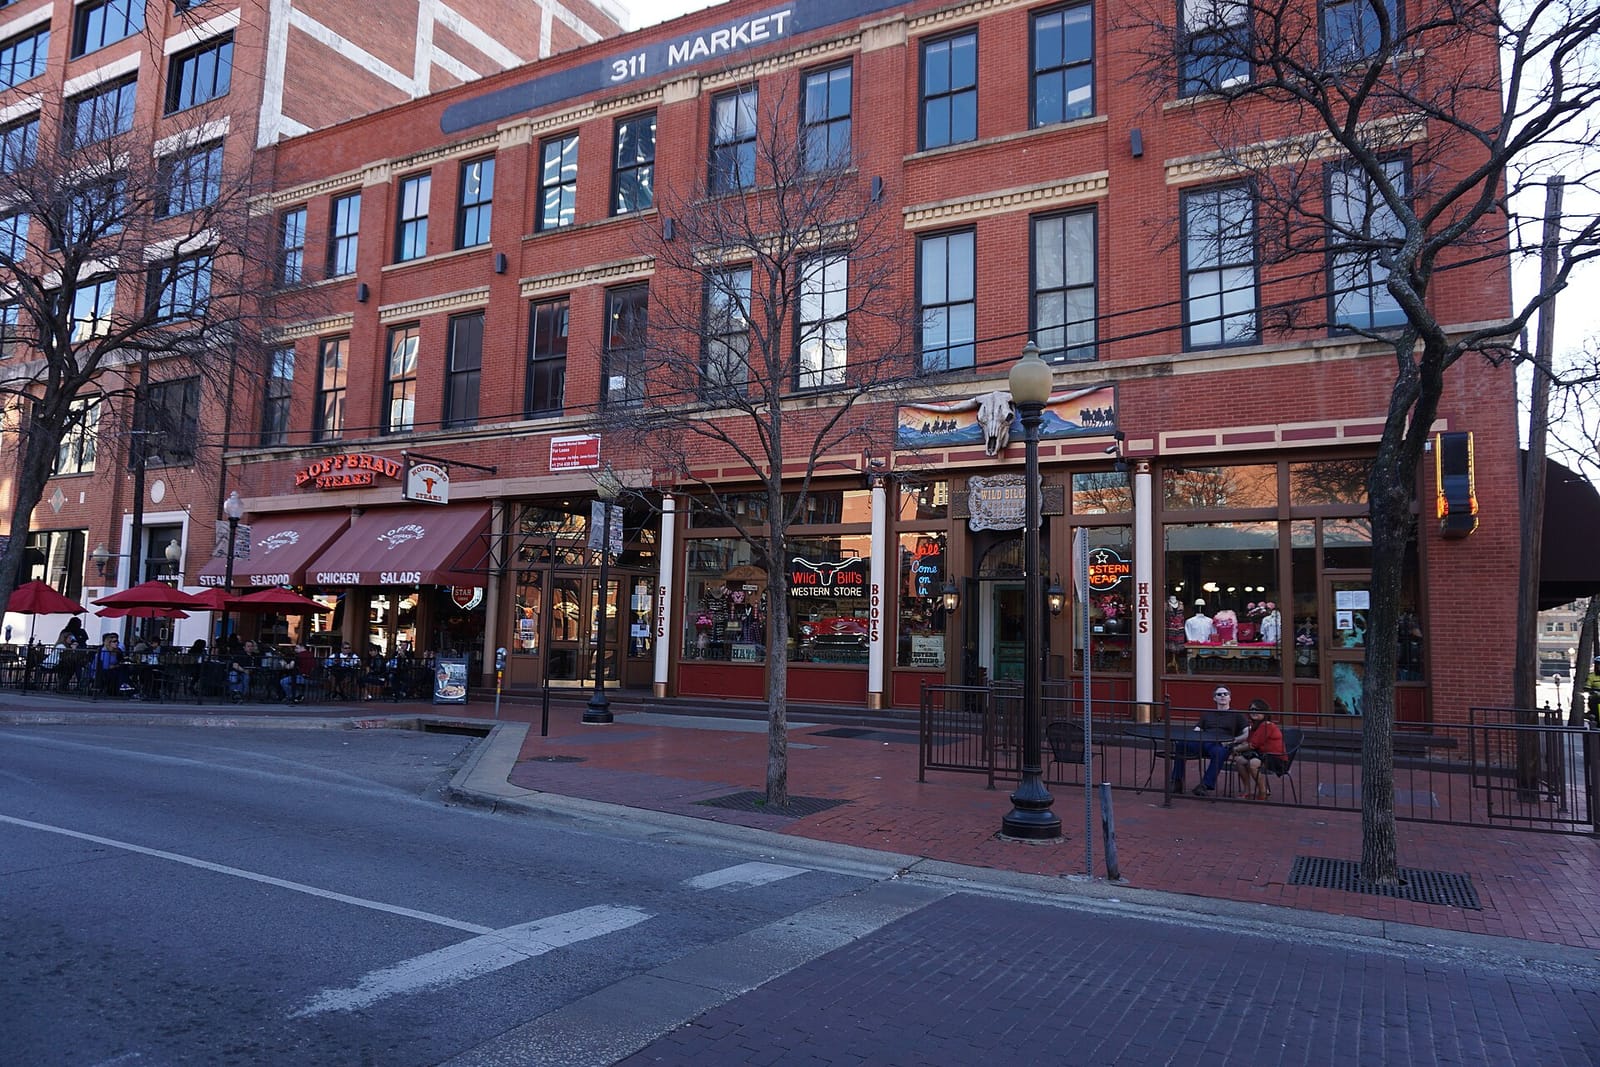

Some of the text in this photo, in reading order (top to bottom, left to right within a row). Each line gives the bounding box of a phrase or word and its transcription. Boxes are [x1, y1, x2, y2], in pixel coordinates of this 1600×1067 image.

[610, 9, 792, 82] 311 MARKET
[295, 453, 400, 486] HOFFBRAU
[315, 472, 373, 488] STEAKS
[981, 487, 1002, 500] WILD
[911, 560, 938, 573] Come
[1087, 564, 1129, 575] ESTERN
[250, 573, 290, 586] SEAFOOD
[316, 572, 360, 584] CHICKEN
[380, 571, 422, 584] SALADS
[792, 571, 863, 585] Wild Bill's
[918, 576, 931, 584] on
[790, 586, 862, 597] WESTERN STORE
[918, 585, 929, 595] in
[657, 585, 667, 638] GIFTS
[870, 584, 880, 642] BOOTS
[1138, 582, 1149, 634] HATS
